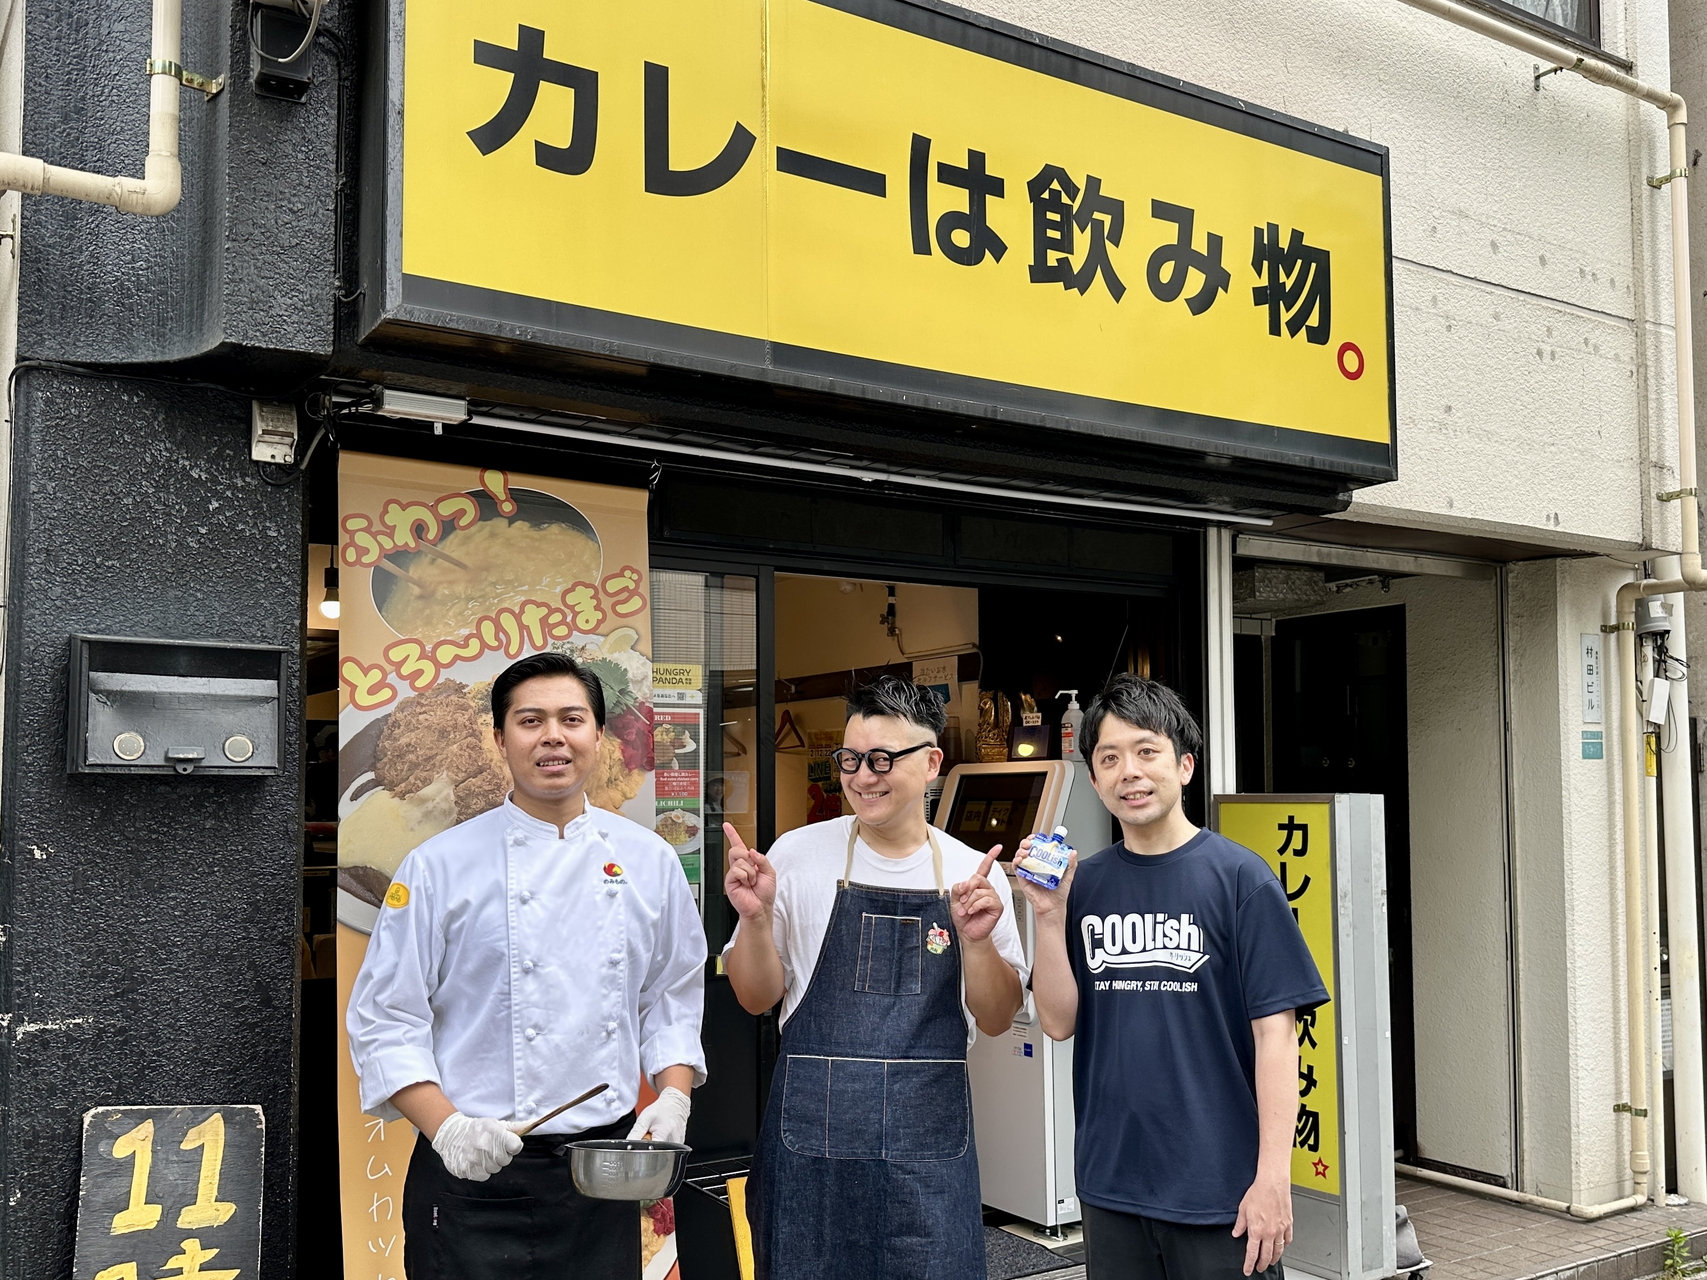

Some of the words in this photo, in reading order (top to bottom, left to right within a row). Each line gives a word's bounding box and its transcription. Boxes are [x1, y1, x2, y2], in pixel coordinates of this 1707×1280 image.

[467, 24, 1365, 381] カレーは飲み物。
[652, 668, 692, 677] HUNGRY
[652, 677, 685, 685] PANDA
[1586, 645, 1595, 711] 村田ビル
[1095, 981, 1111, 991] TAY
[1160, 980, 1198, 992] COOLISH
[110, 1112, 237, 1235] 11
[364, 1117, 394, 1280] オムカツ
